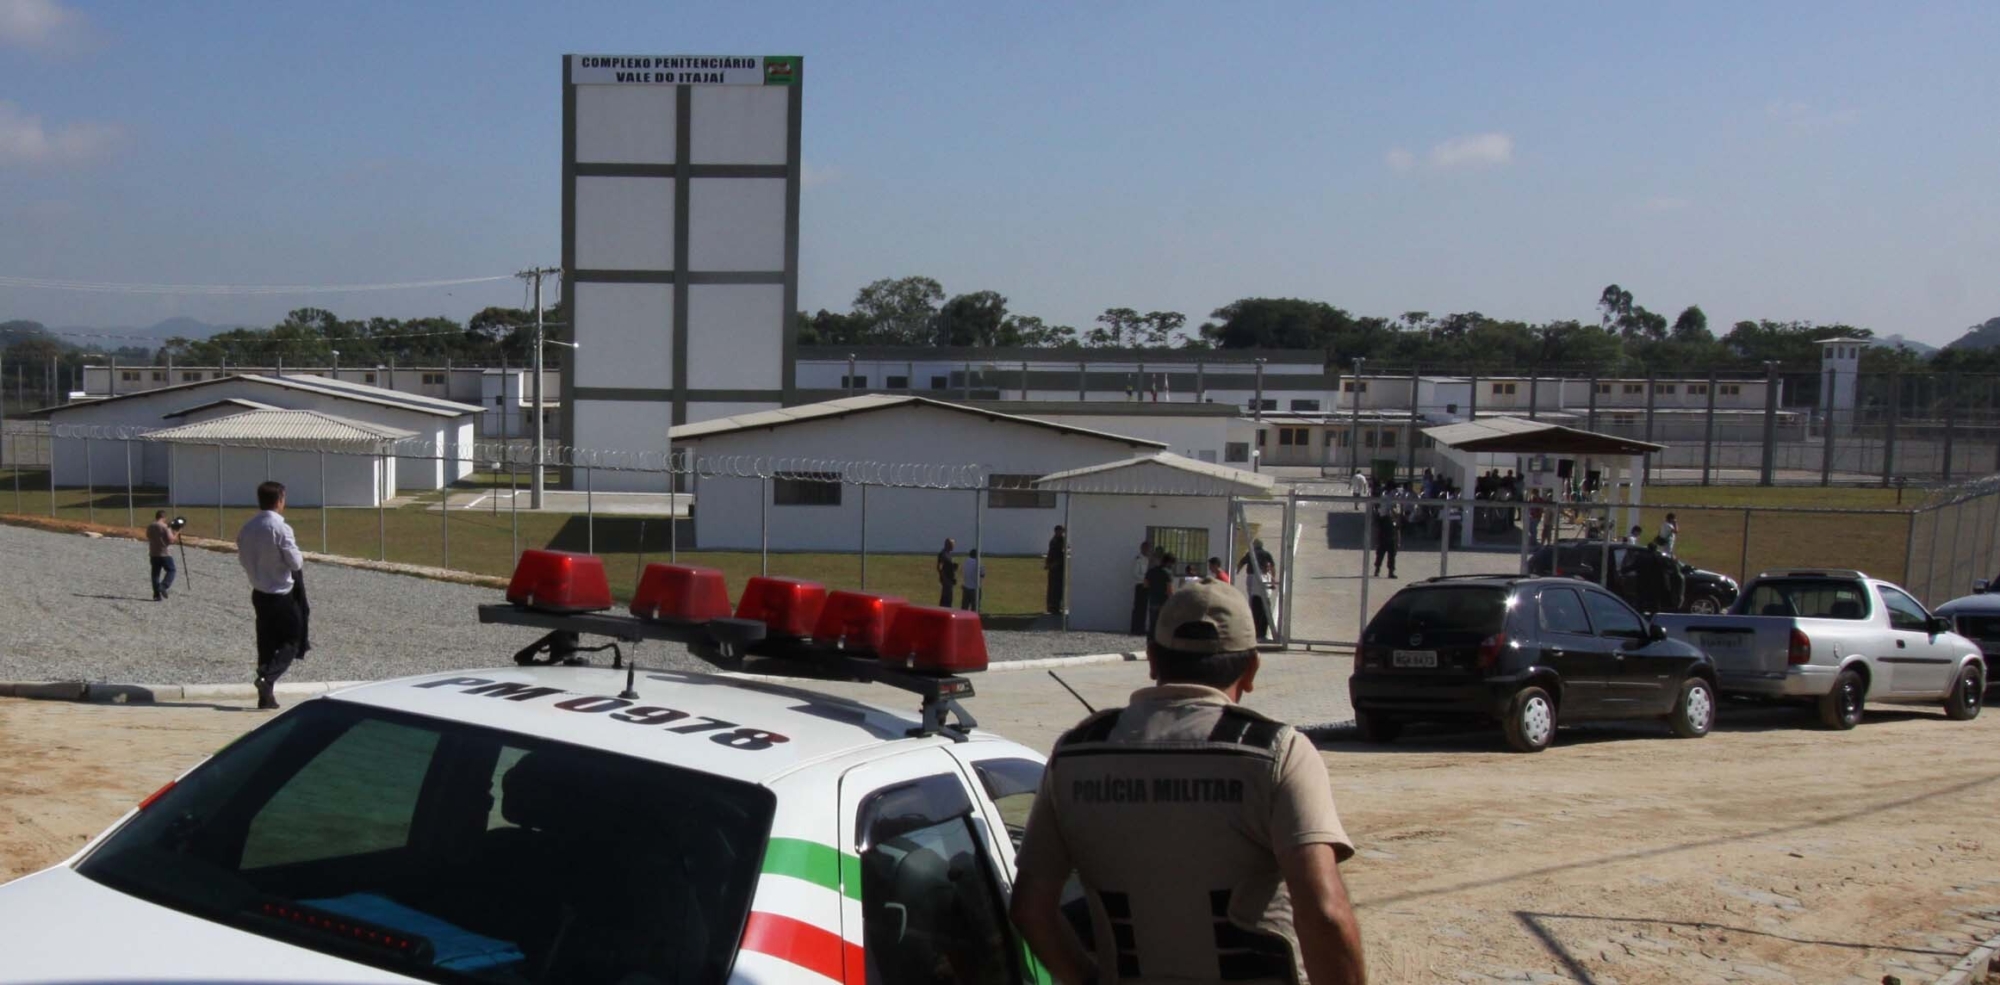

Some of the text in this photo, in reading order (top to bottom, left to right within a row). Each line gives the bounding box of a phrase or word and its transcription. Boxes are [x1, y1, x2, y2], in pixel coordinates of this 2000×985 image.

[582, 56, 756, 69] COMPLEXO PENITENCIÁRIO
[616, 70, 725, 83] VALE DO ITAJAÍ
[409, 676, 791, 751] PM 0978
[1072, 774, 1244, 803] POLÍCIA MILITAR
